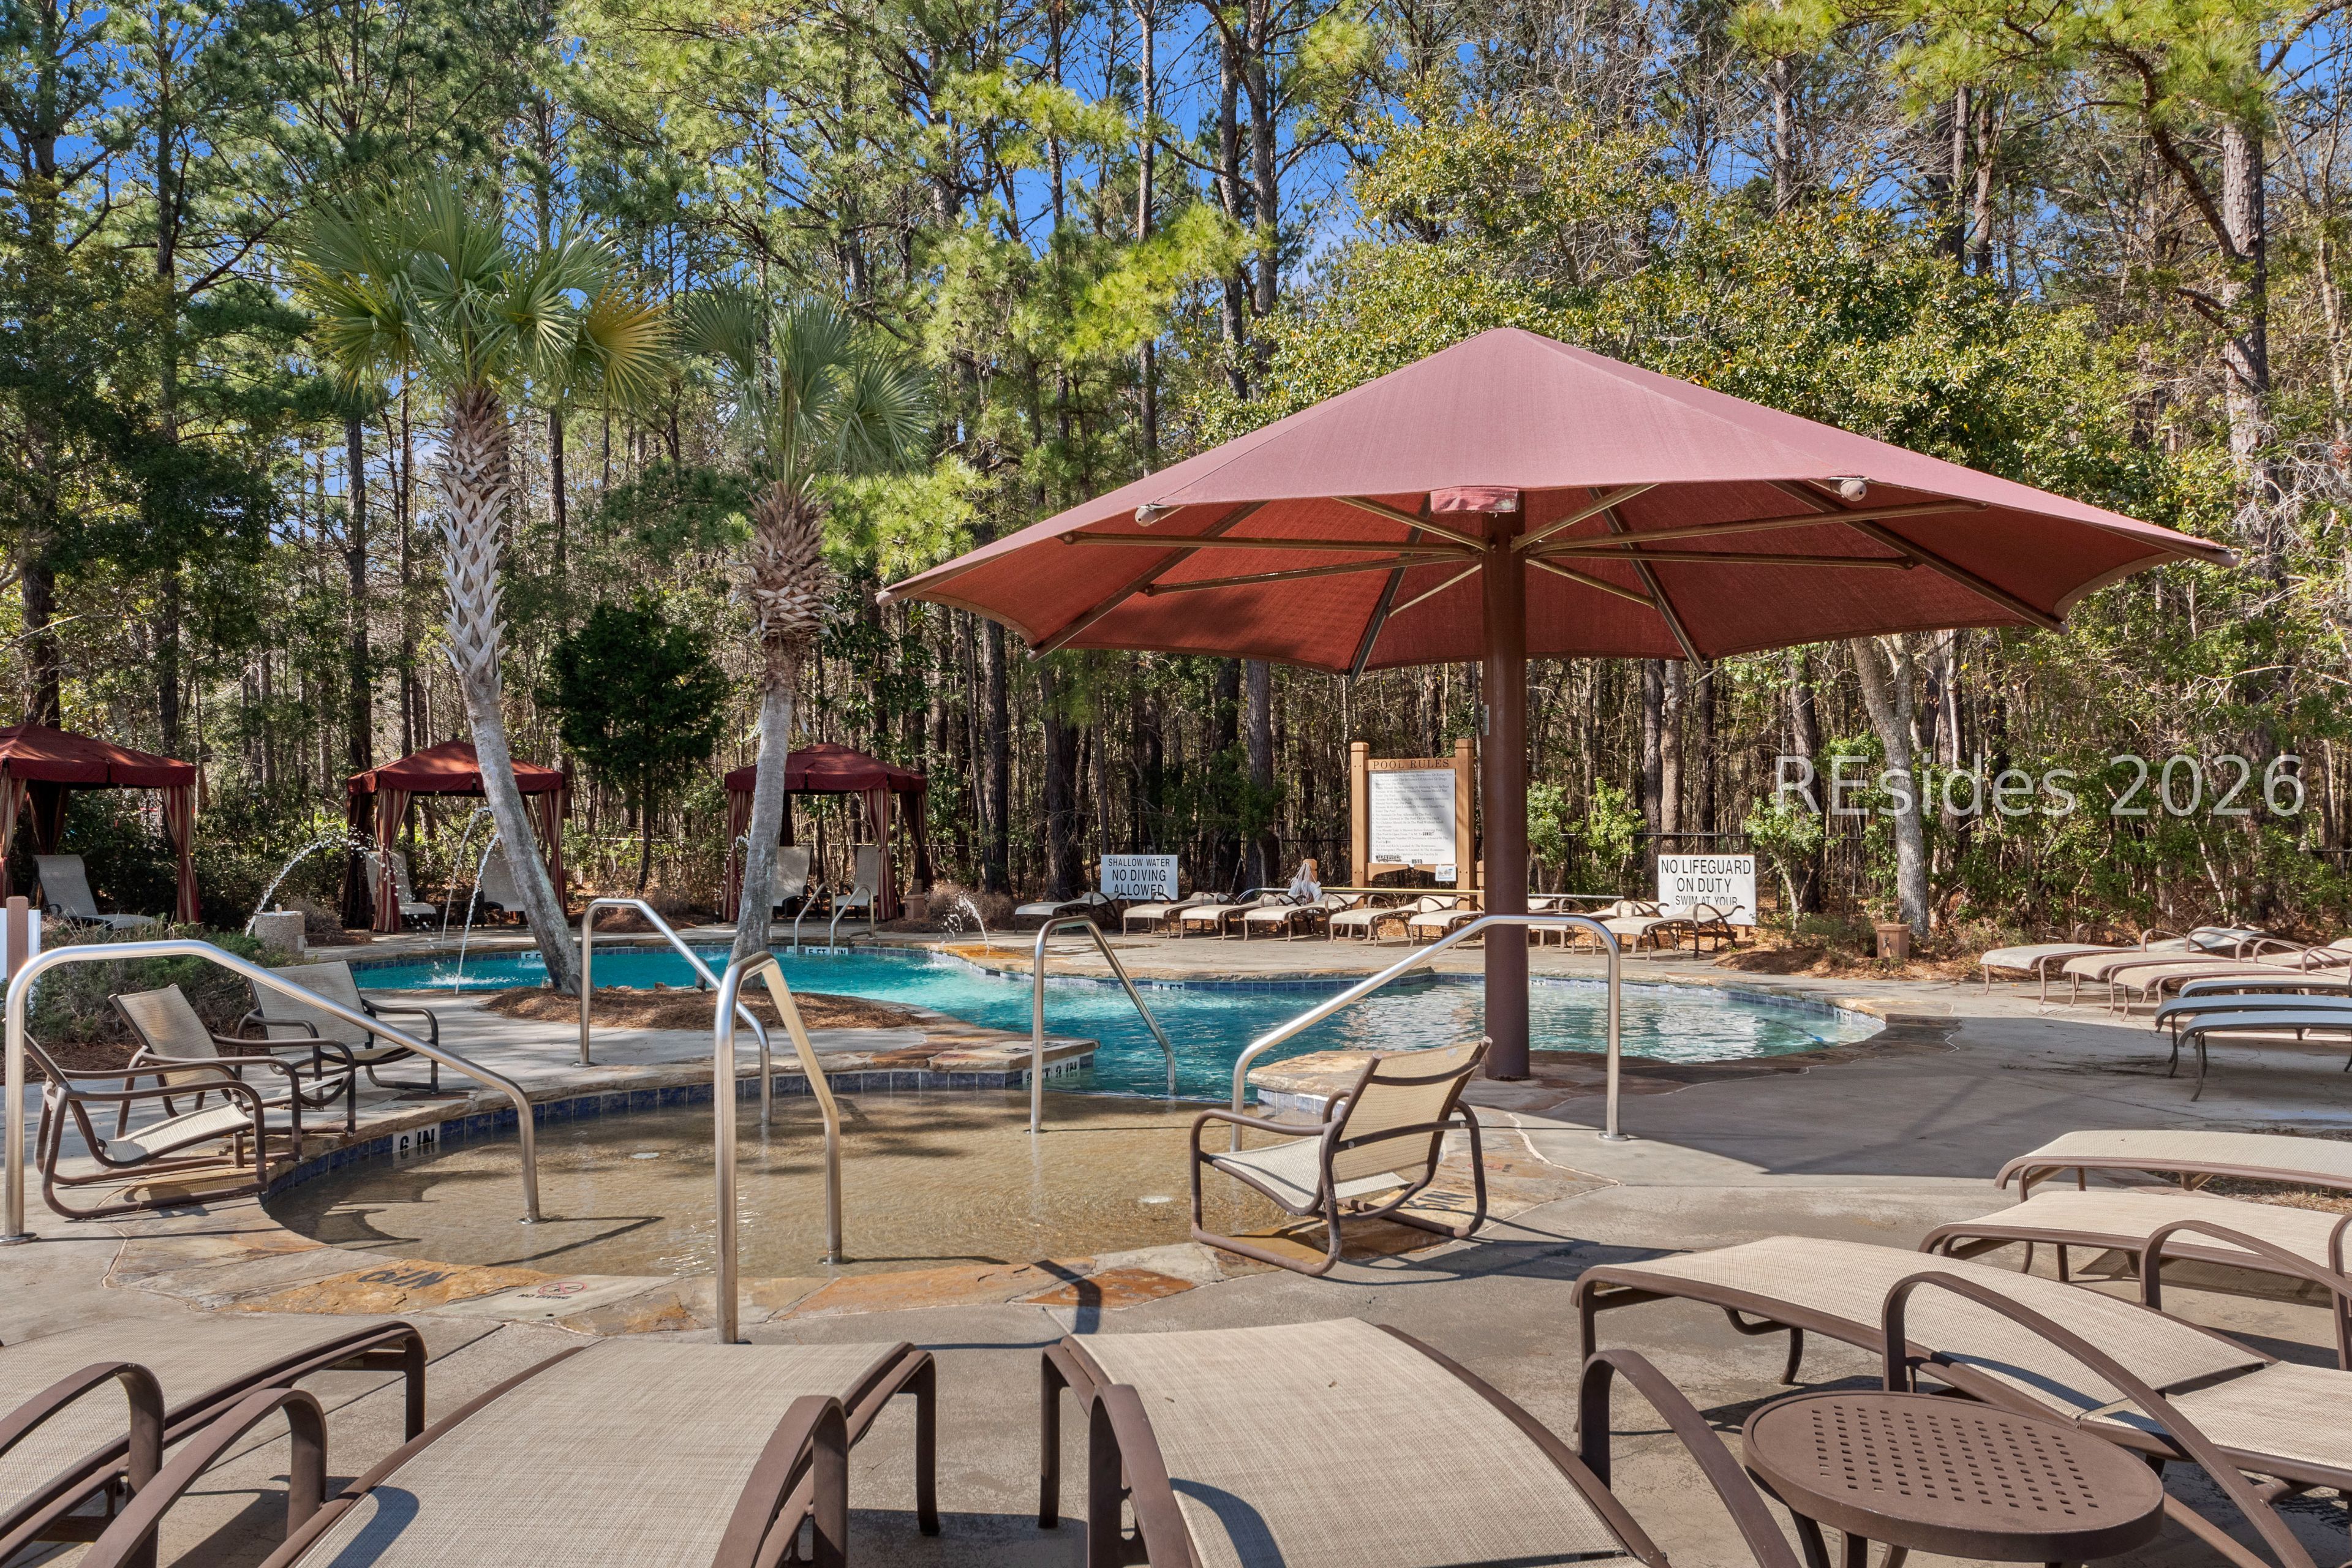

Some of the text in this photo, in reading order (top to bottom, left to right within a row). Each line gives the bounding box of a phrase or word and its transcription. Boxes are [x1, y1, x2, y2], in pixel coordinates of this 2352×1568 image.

[1411, 760, 1449, 769] RULES
[1661, 859, 1751, 875] NO LIFEGUARD
[1112, 870, 1166, 881] NO DIVING
[1114, 884, 1164, 895] ALLOWED
[1677, 878, 1732, 893] ON DUTY
[1675, 895, 1738, 905] SWIM AT YOUR
[417, 1128, 435, 1145] IN
